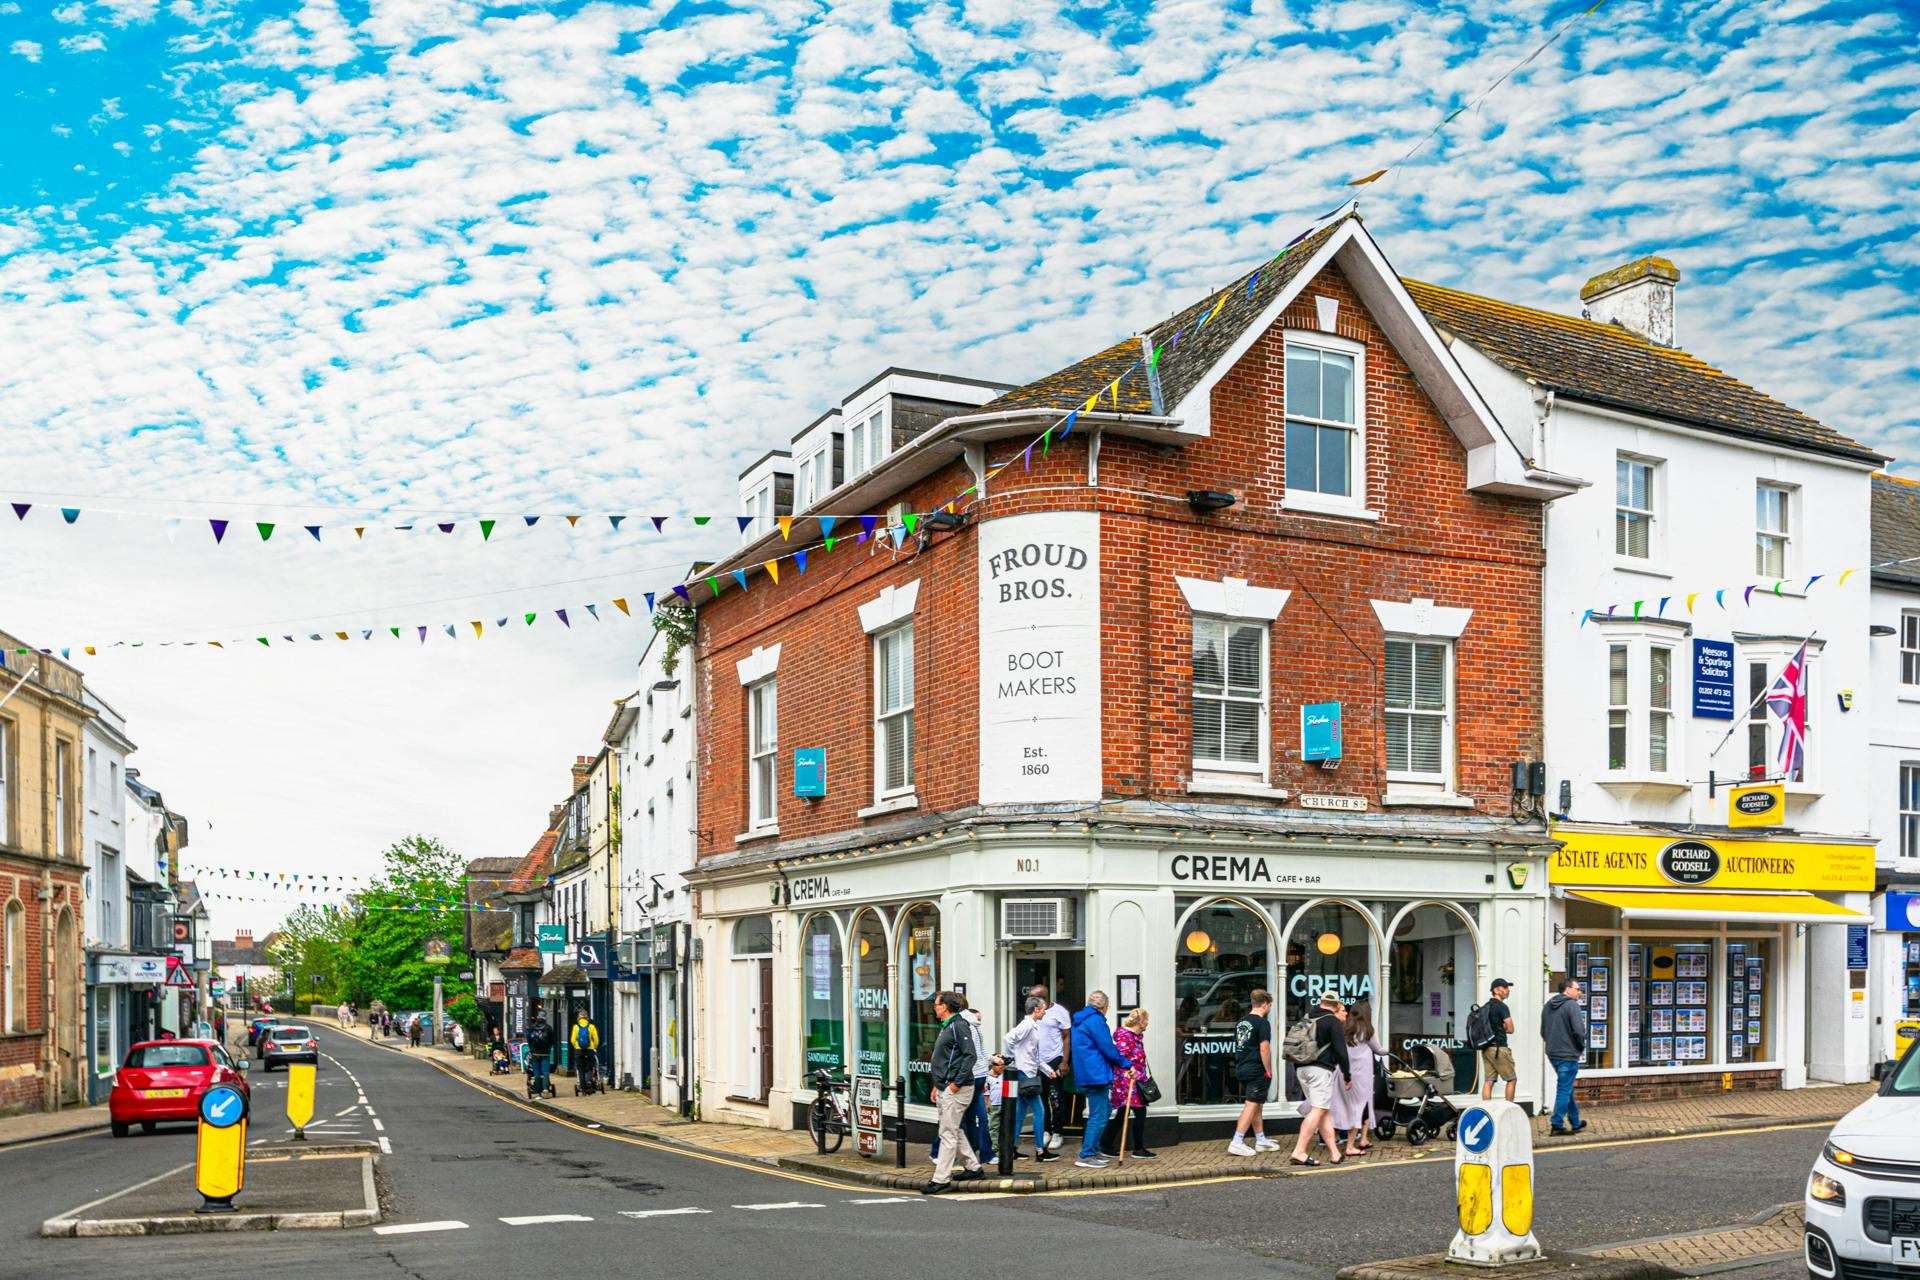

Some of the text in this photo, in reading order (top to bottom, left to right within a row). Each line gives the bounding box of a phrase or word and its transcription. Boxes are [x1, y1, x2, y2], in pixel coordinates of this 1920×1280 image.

[989, 543, 1088, 579] FROUD
[999, 578, 1073, 603] BROS.
[1008, 651, 1064, 672] BOOT
[1698, 655, 1704, 664] &
[1701, 667, 1728, 678] Solicitors
[998, 677, 1076, 699] MAKERS
[1023, 747, 1048, 759] Est.
[1022, 764, 1050, 776] 1860
[1304, 797, 1349, 808] CHURCH
[1741, 801, 1770, 809] GODSELL
[1742, 794, 1770, 802] RICHARD
[1557, 850, 1647, 870] ESTATE AGENTS
[1672, 849, 1711, 860] RICHARD
[1171, 855, 1271, 882] CREMA
[1276, 875, 1297, 883] CAFE
[1305, 876, 1321, 884] BAR
[1671, 860, 1711, 872] GODSELL
[1725, 857, 1795, 875] AUCTIONEERS
[794, 877, 830, 900] CREMA
[580, 945, 601, 964] SA
[1290, 974, 1376, 998] CREMA
[1184, 1041, 1238, 1056] SANDWI
[807, 1051, 840, 1065] SANDWICHES
[861, 1064, 882, 1074] COFFEE
[908, 1061, 932, 1073] COCKTA
